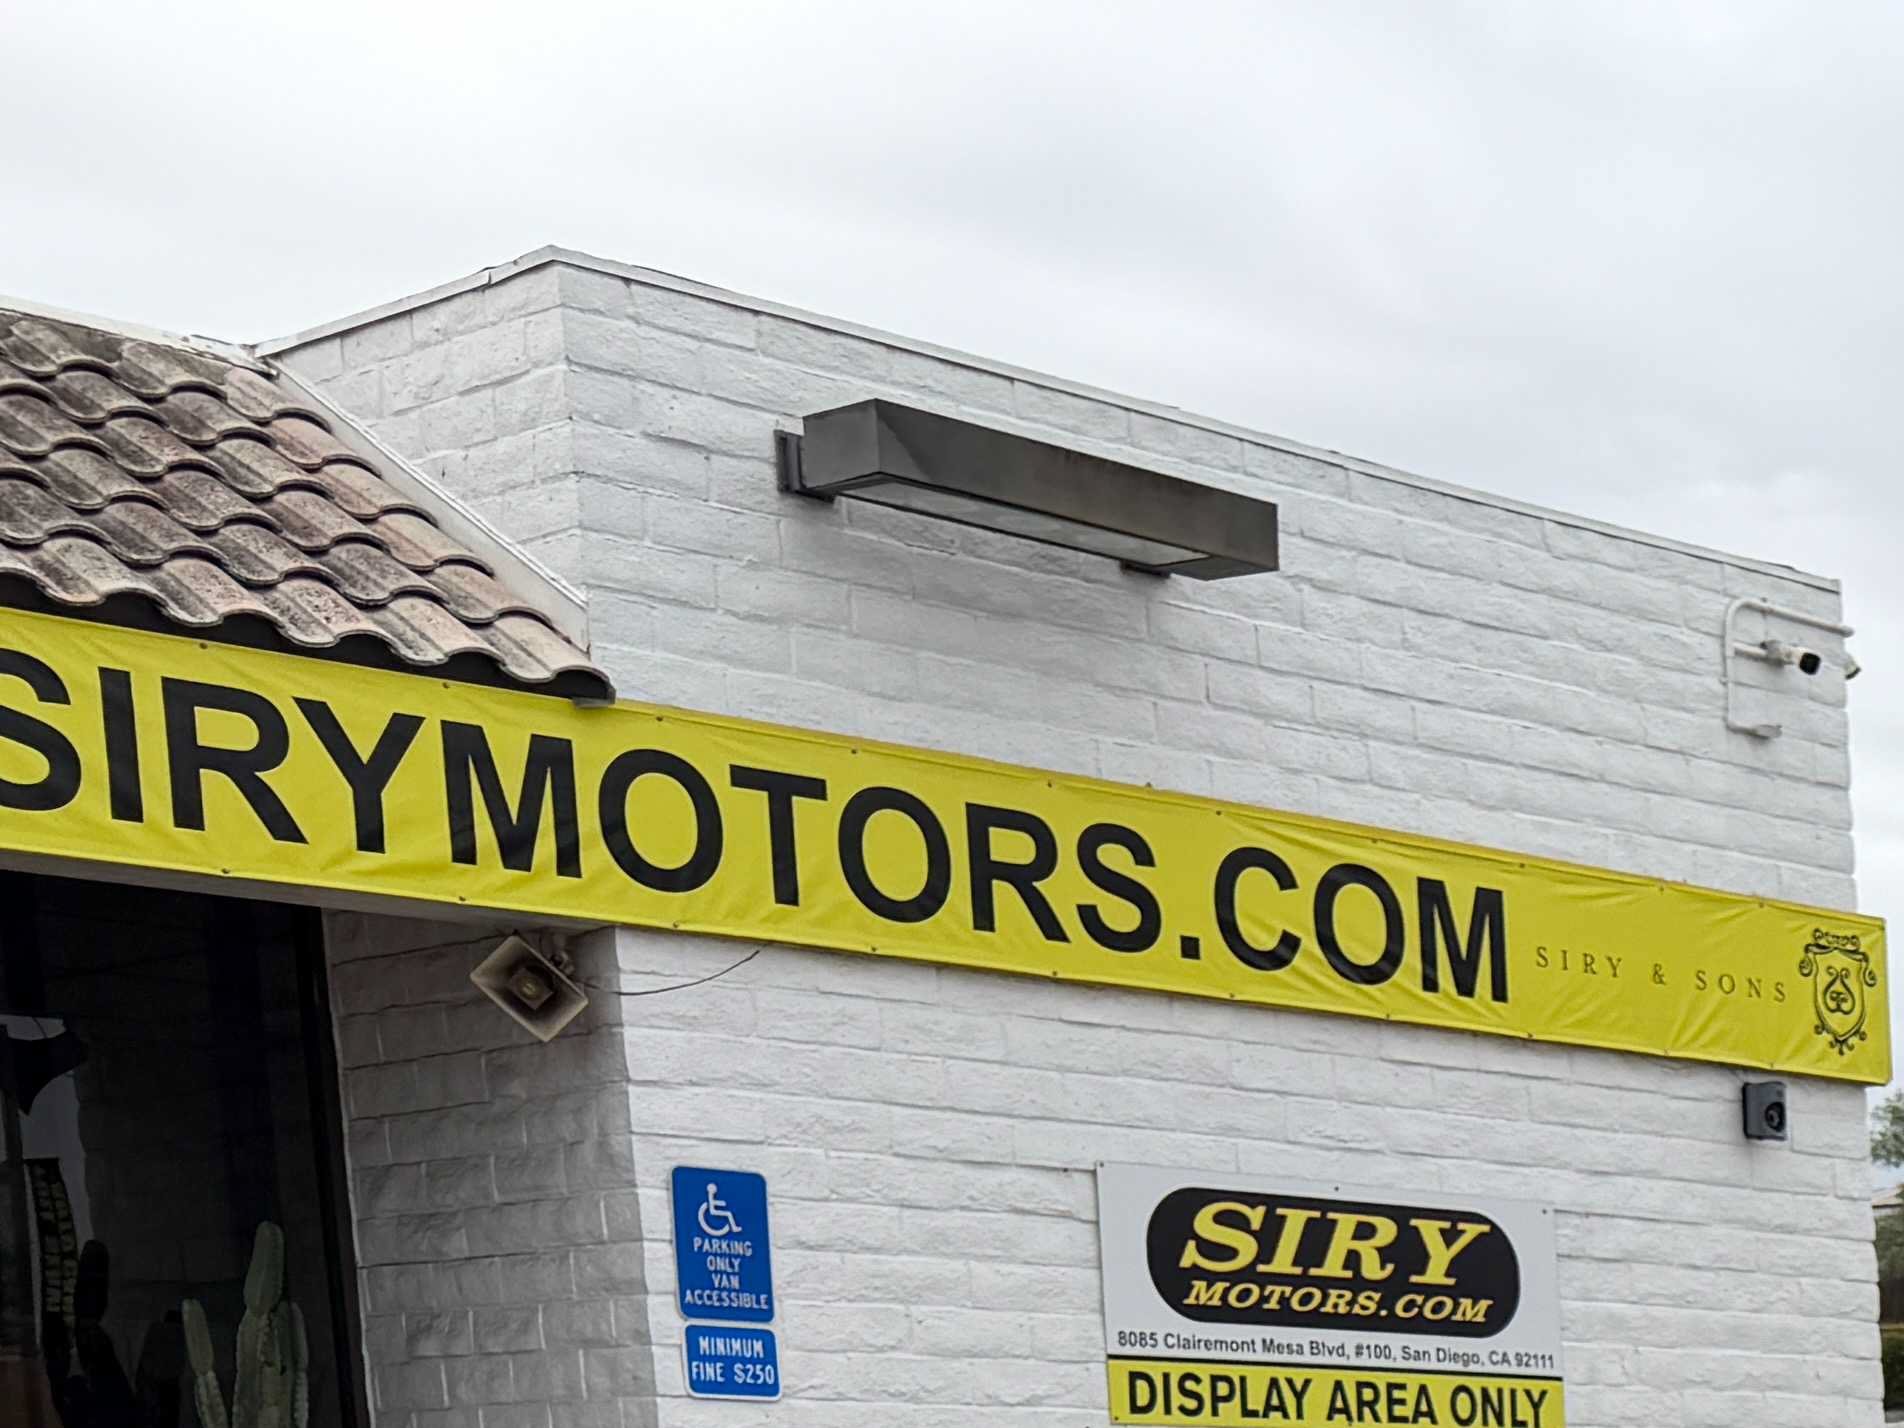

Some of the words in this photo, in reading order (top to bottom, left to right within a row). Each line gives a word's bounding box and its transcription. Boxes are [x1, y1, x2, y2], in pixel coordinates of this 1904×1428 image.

[0, 648, 1508, 1004] SIRYMOTORS.COM
[1536, 946, 1622, 978] SIRY
[1652, 964, 1666, 985] &
[1695, 970, 1786, 1003] SONS
[693, 1237, 753, 1257] PARKING
[1179, 1200, 1491, 1286] SIRY
[706, 1257, 741, 1273] ONLY
[711, 1273, 740, 1290] VAN
[685, 1289, 769, 1310] ACCESSIBLE
[1183, 1280, 1493, 1323] MOTORS.COM
[698, 1336, 765, 1359] MINIMUM
[1117, 1330, 1158, 1348] 8085
[1163, 1332, 1257, 1354] Clairemont
[1261, 1337, 1305, 1356] Mesa
[1309, 1339, 1350, 1360] Blvd,
[1401, 1345, 1431, 1361] San
[1488, 1350, 1511, 1367] CA
[1515, 1352, 1554, 1369] 92111
[691, 1361, 726, 1383] FINE
[734, 1363, 775, 1385] $250
[1128, 1370, 1313, 1420] DISPLAY
[1326, 1379, 1438, 1425] AREA
[1450, 1384, 1548, 1428] ONLY
